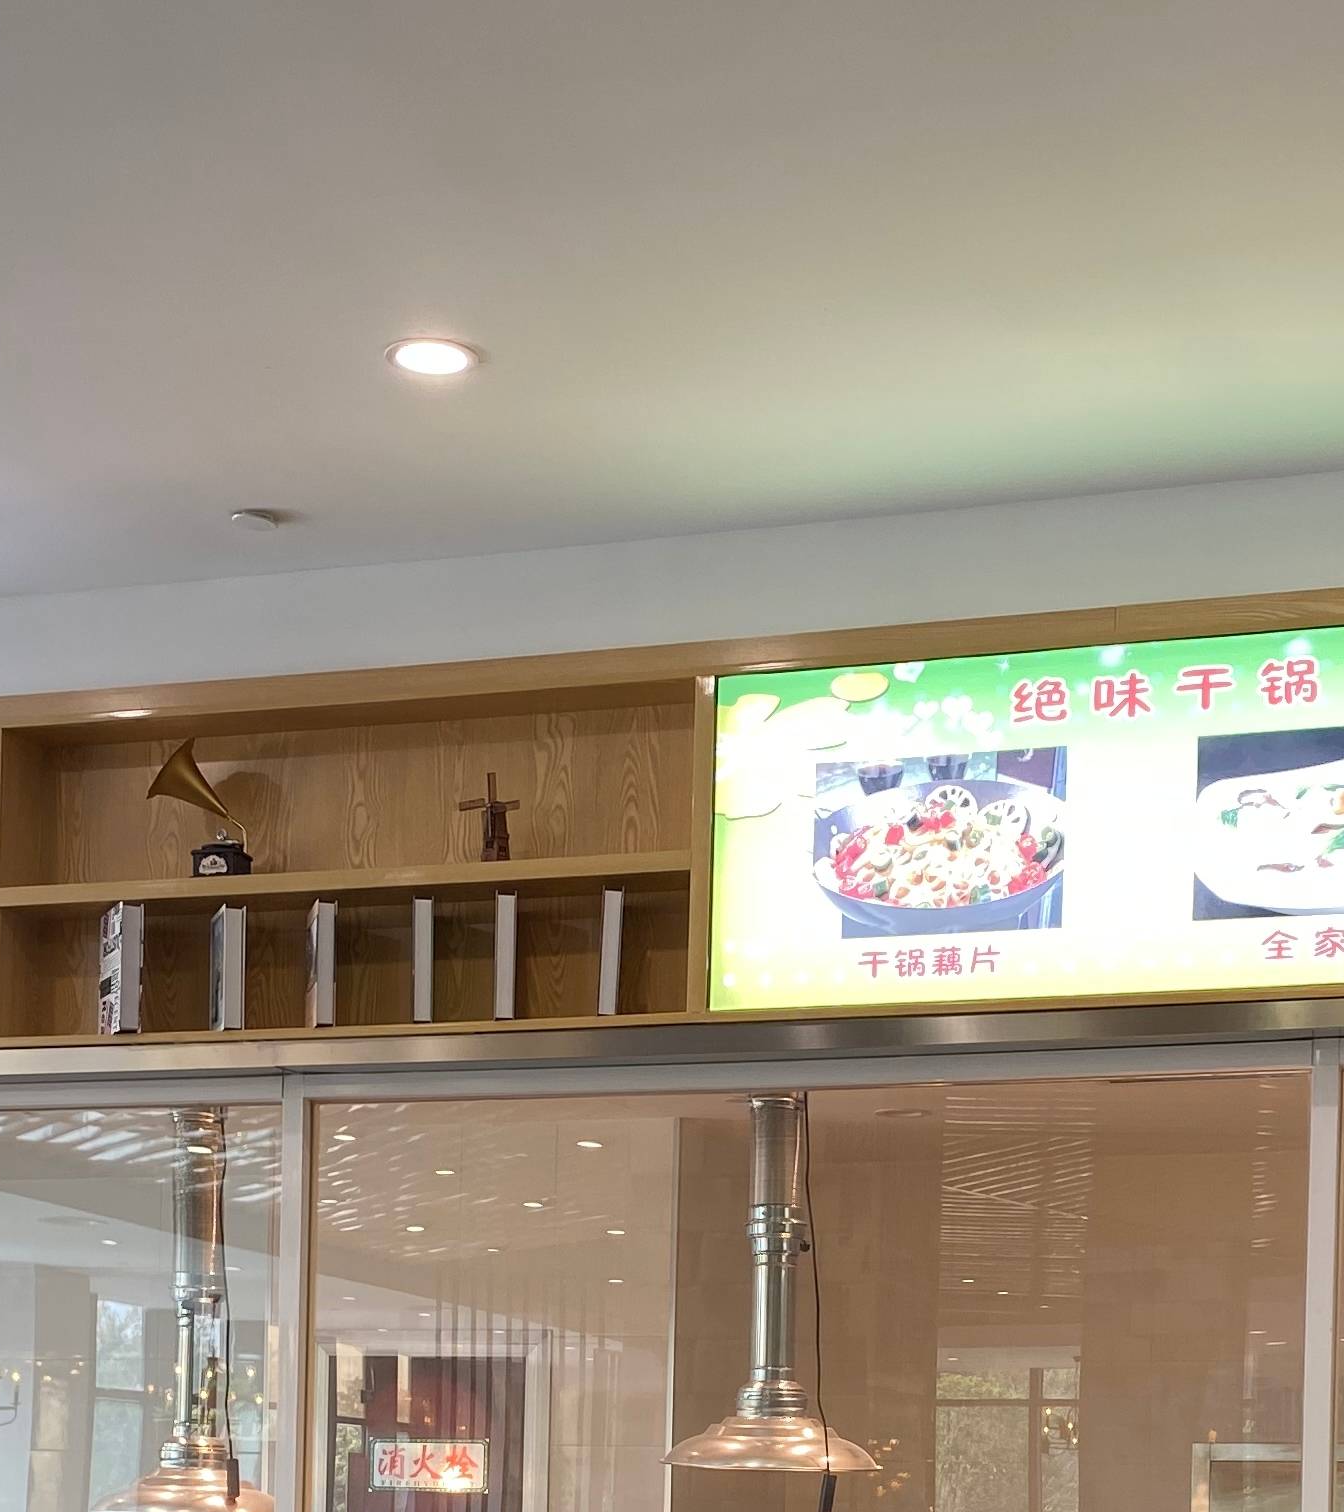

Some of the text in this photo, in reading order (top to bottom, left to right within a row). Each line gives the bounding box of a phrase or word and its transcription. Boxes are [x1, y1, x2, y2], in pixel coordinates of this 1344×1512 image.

[1011, 657, 1320, 725] 绝味干锅
[858, 945, 1001, 980] 干锅藕片
[378, 1444, 479, 1480] 消火栓
